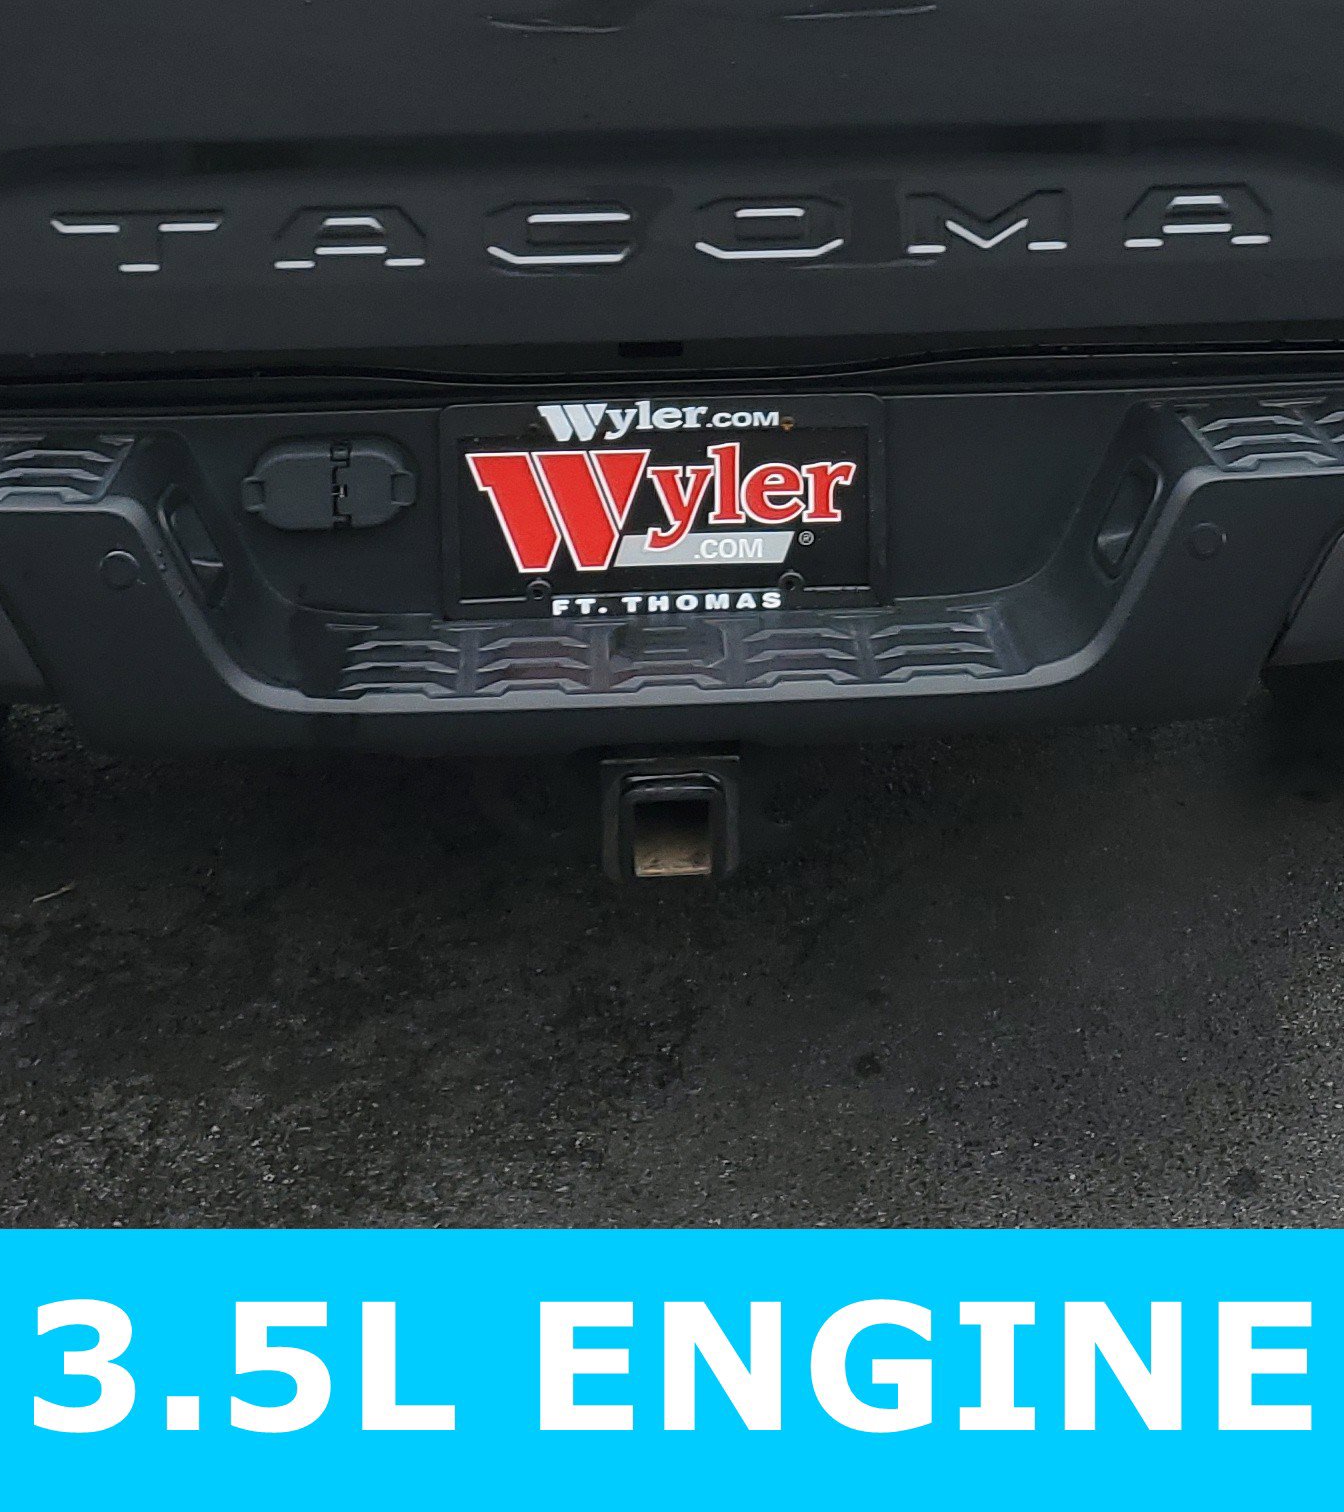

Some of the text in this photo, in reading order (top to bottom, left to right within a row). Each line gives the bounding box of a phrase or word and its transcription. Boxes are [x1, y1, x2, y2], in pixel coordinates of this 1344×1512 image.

[50, 182, 1273, 274] TACOMA
[464, 441, 857, 574] Wyler
[693, 537, 764, 560] .COM
[551, 591, 782, 616] FT. THOMAS
